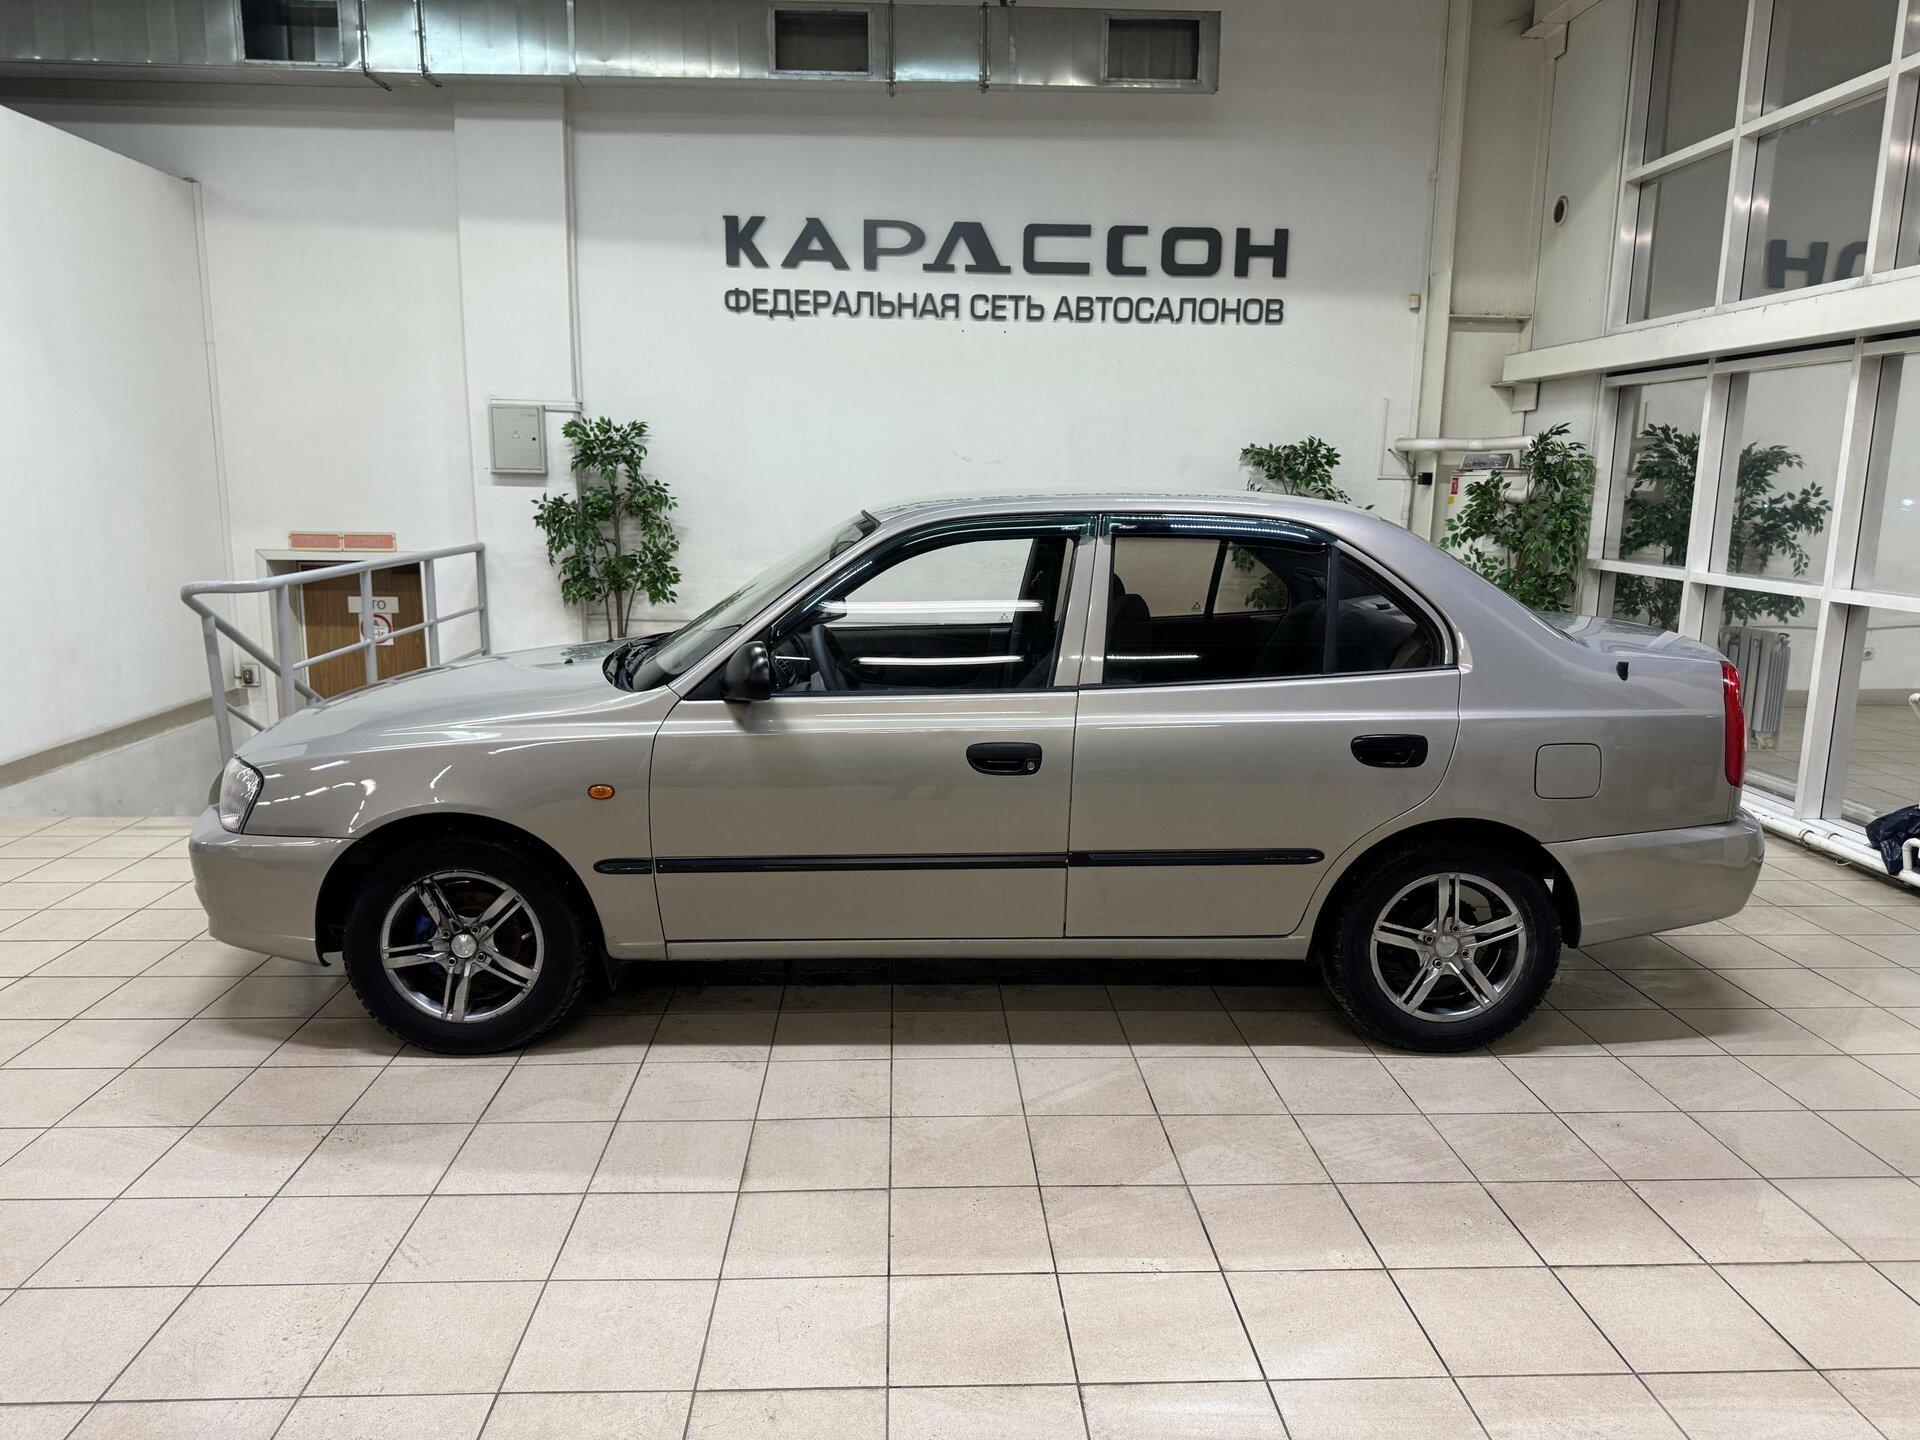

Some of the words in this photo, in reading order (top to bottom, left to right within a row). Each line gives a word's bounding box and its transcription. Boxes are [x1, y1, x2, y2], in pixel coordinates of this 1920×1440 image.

[724, 287, 960, 319] ФЕДЕРАЛЬНАЯ
[970, 294, 1045, 321] СЕТЬ
[1053, 295, 1284, 324] АВТОСАЛОНОВ
